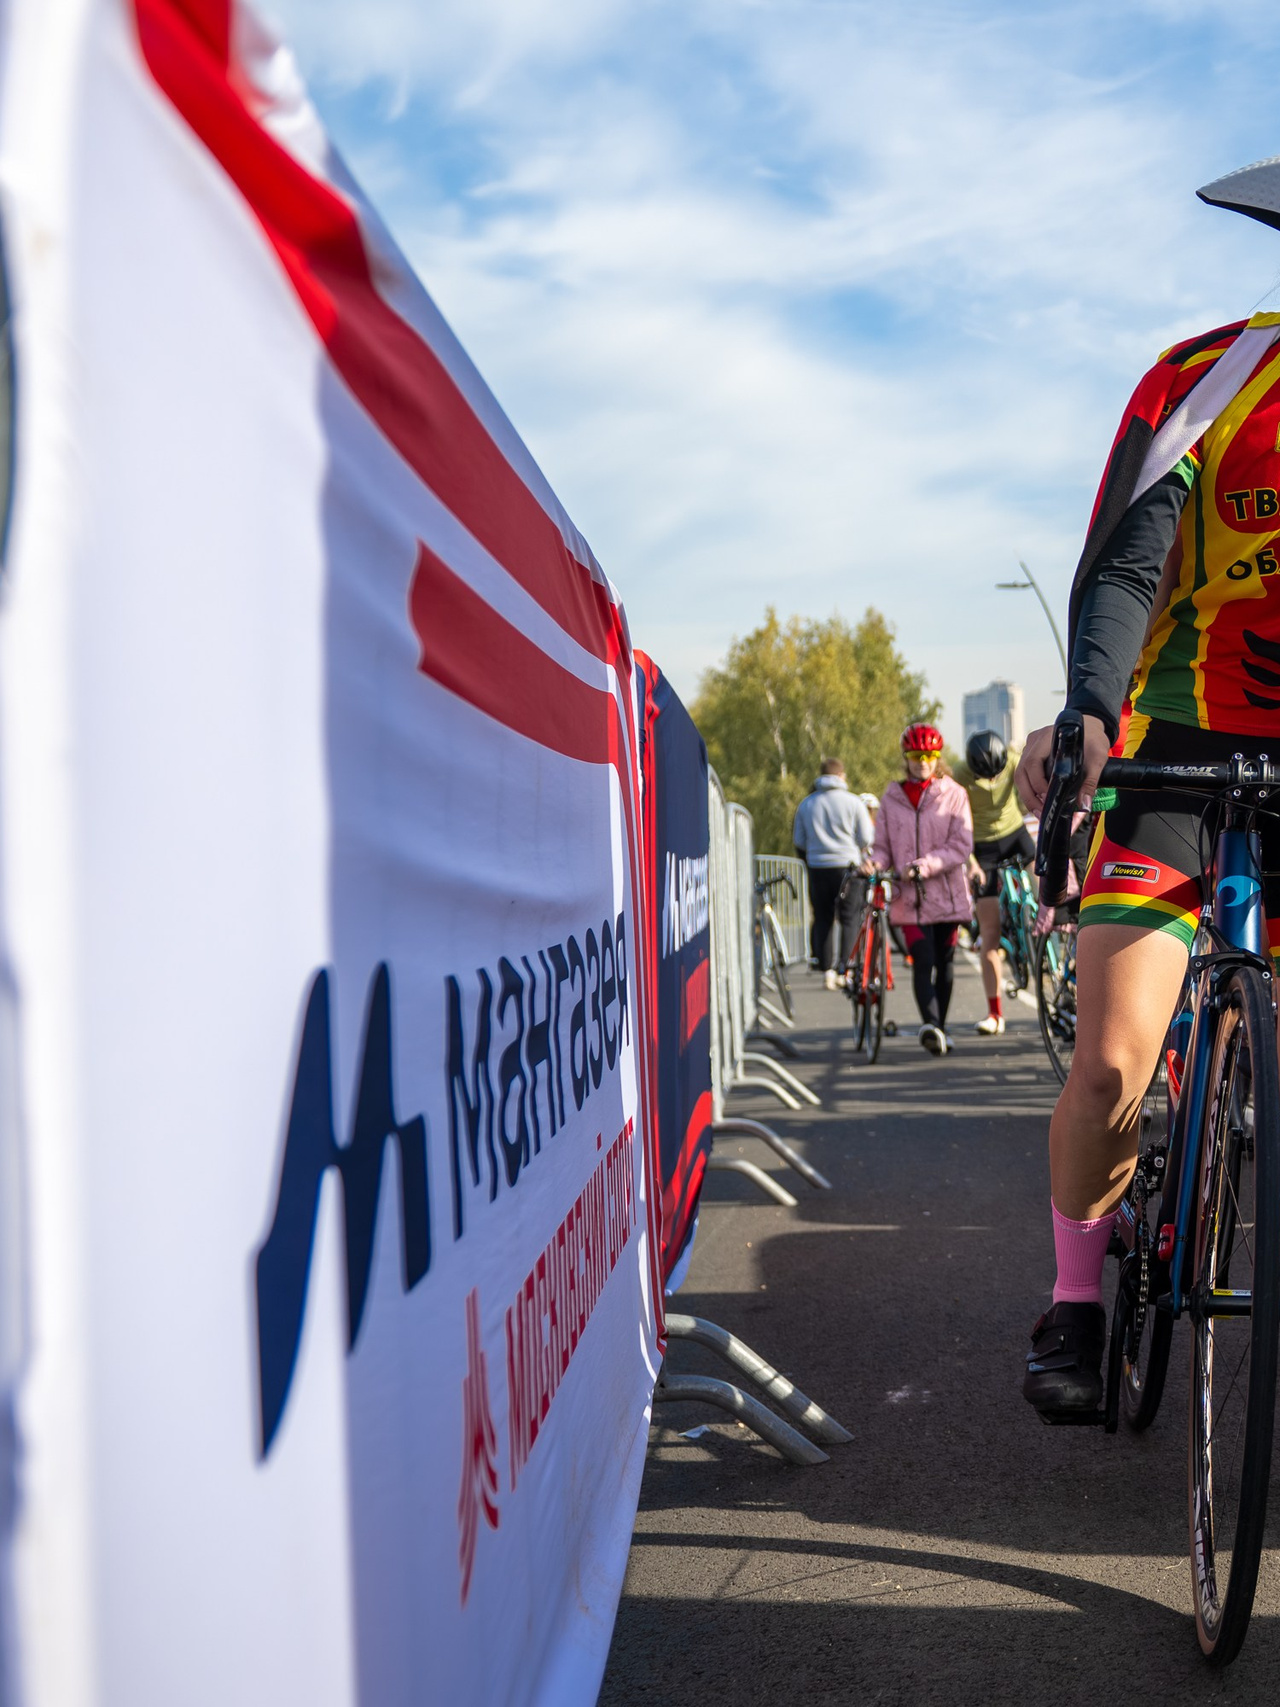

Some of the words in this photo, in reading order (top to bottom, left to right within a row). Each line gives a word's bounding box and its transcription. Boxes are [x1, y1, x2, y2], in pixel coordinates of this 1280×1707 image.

[1112, 866, 1145, 877] Newish
[504, 1132, 608, 1493] МОСКОВСКИЙ
[606, 1115, 637, 1273] СПОРТ
